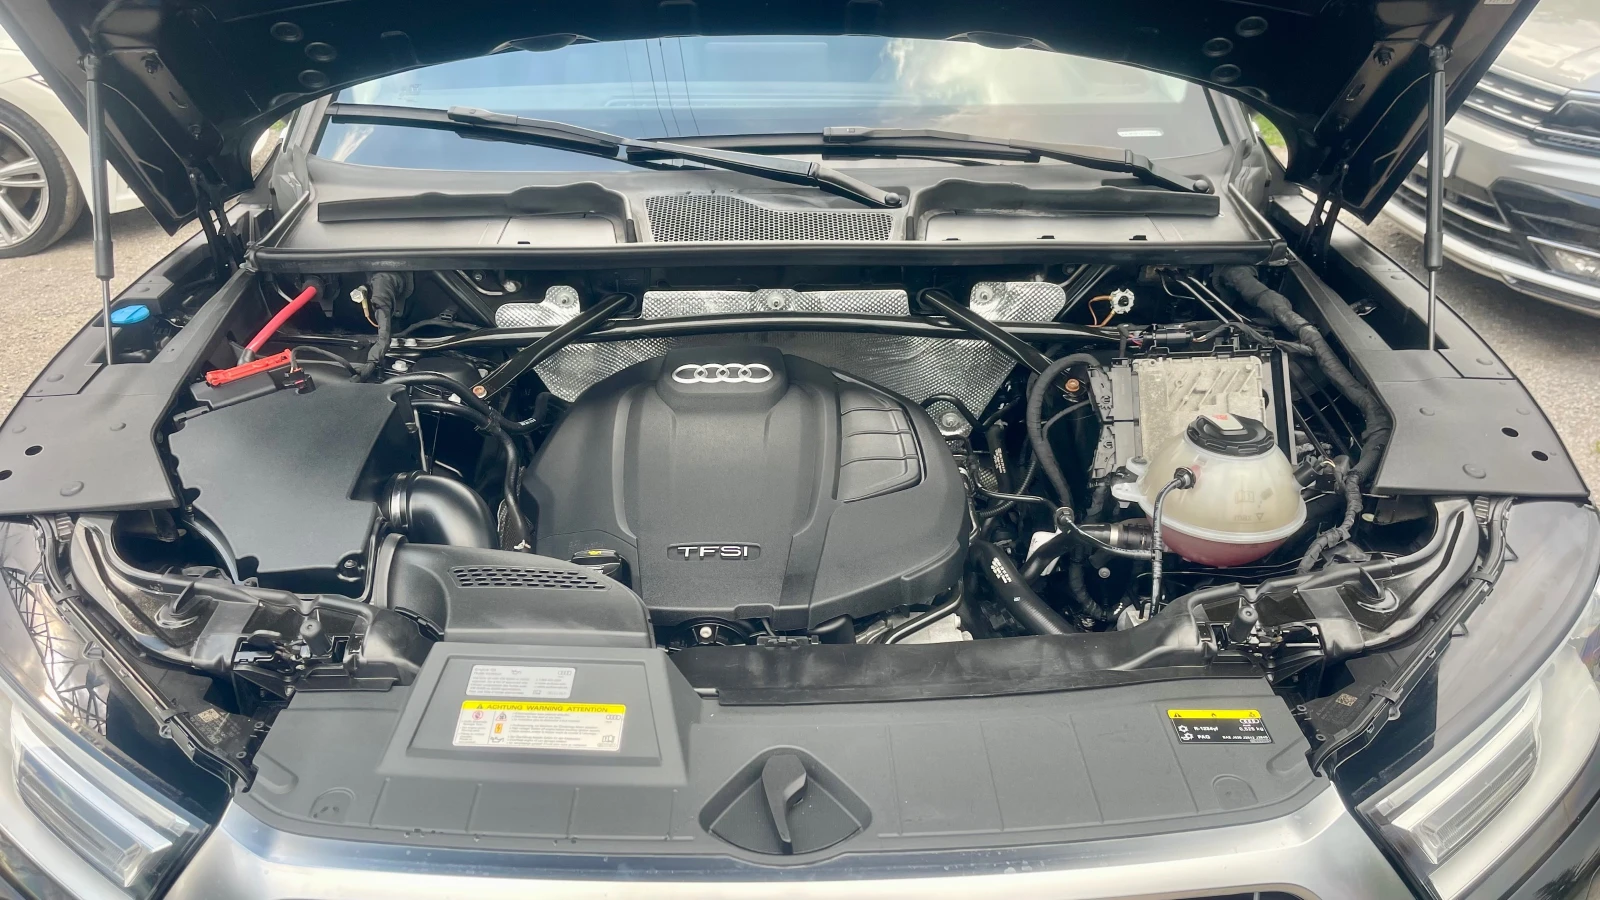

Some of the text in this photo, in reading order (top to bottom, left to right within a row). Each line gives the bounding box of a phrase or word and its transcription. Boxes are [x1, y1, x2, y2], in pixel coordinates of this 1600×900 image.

[677, 545, 748, 557] TFSI
[486, 703, 523, 711] ACHTUNG
[566, 705, 608, 713] ATTENTION
